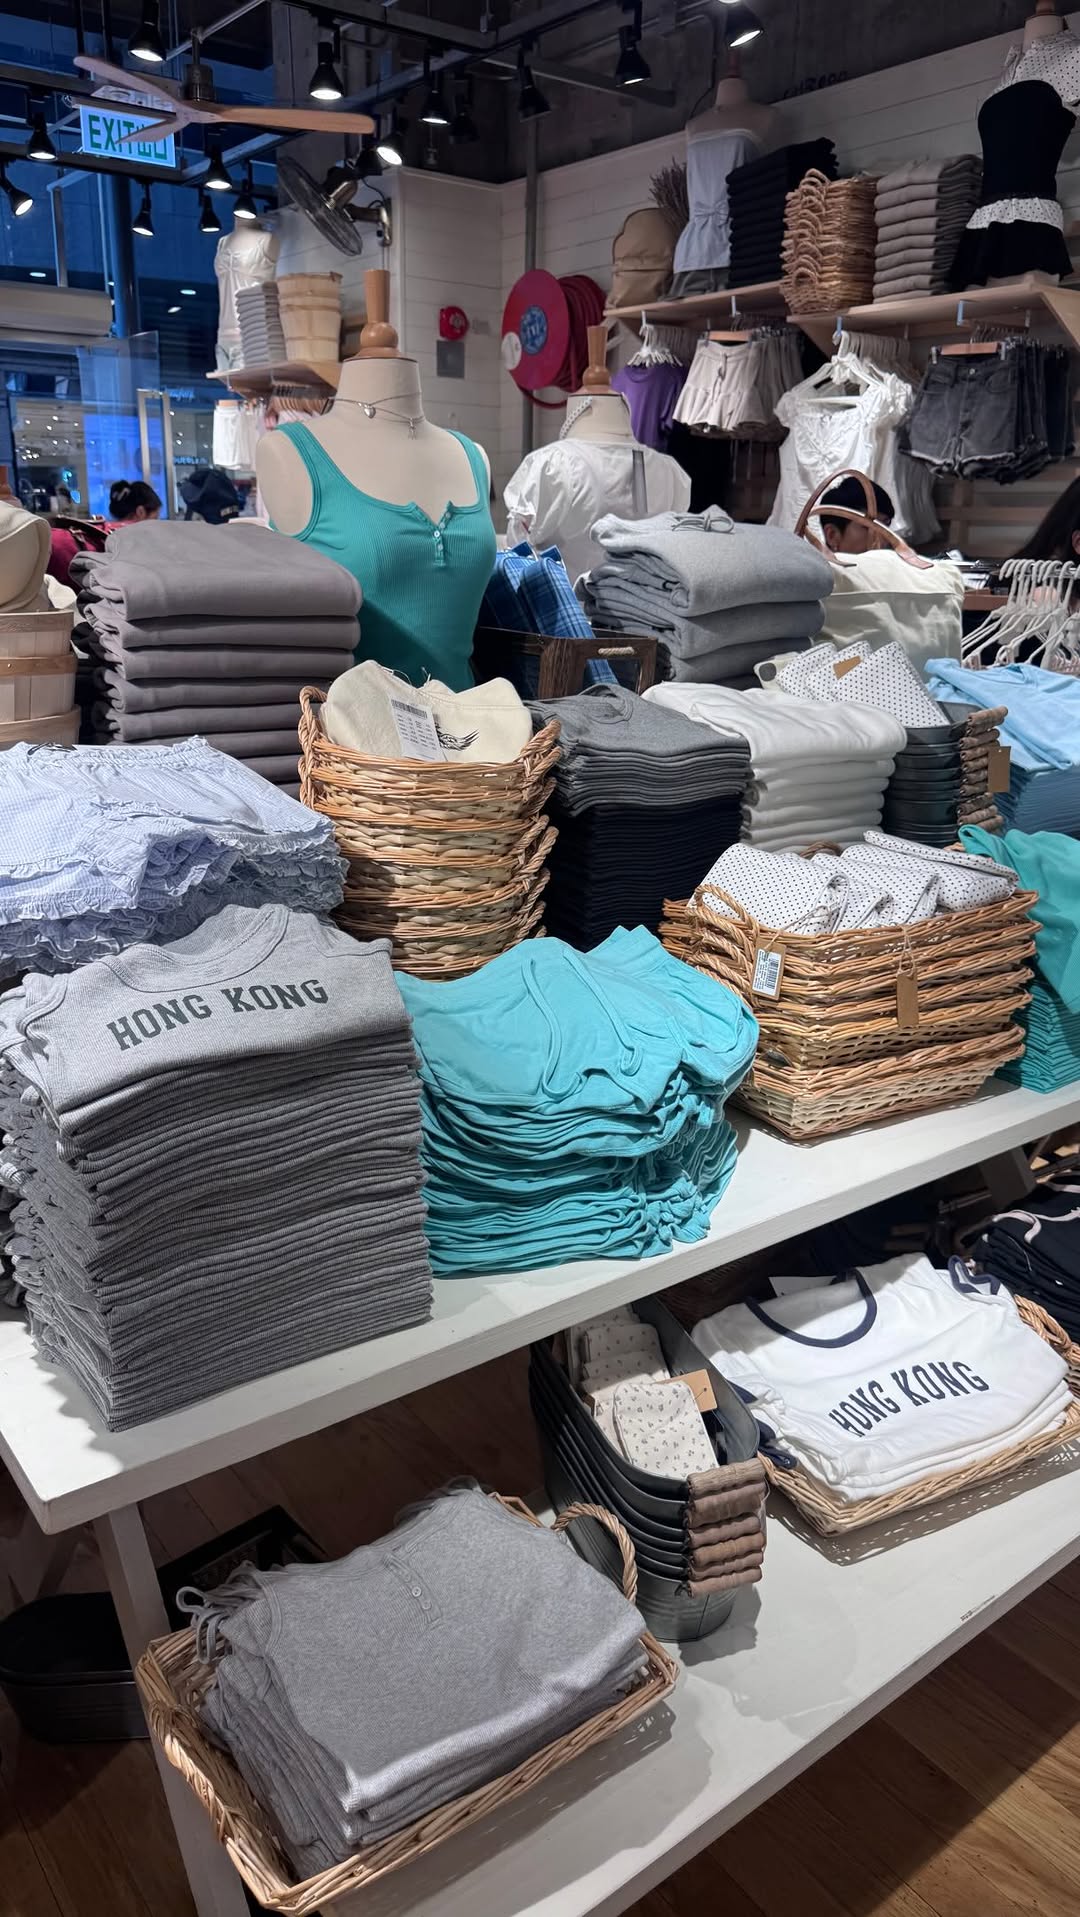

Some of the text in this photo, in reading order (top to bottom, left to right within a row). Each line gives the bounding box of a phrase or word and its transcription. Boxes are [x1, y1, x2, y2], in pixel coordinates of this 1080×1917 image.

[88, 114, 134, 155] EXIT
[106, 979, 329, 1051] HONG KONG
[828, 1361, 990, 1438] HONG KONG
